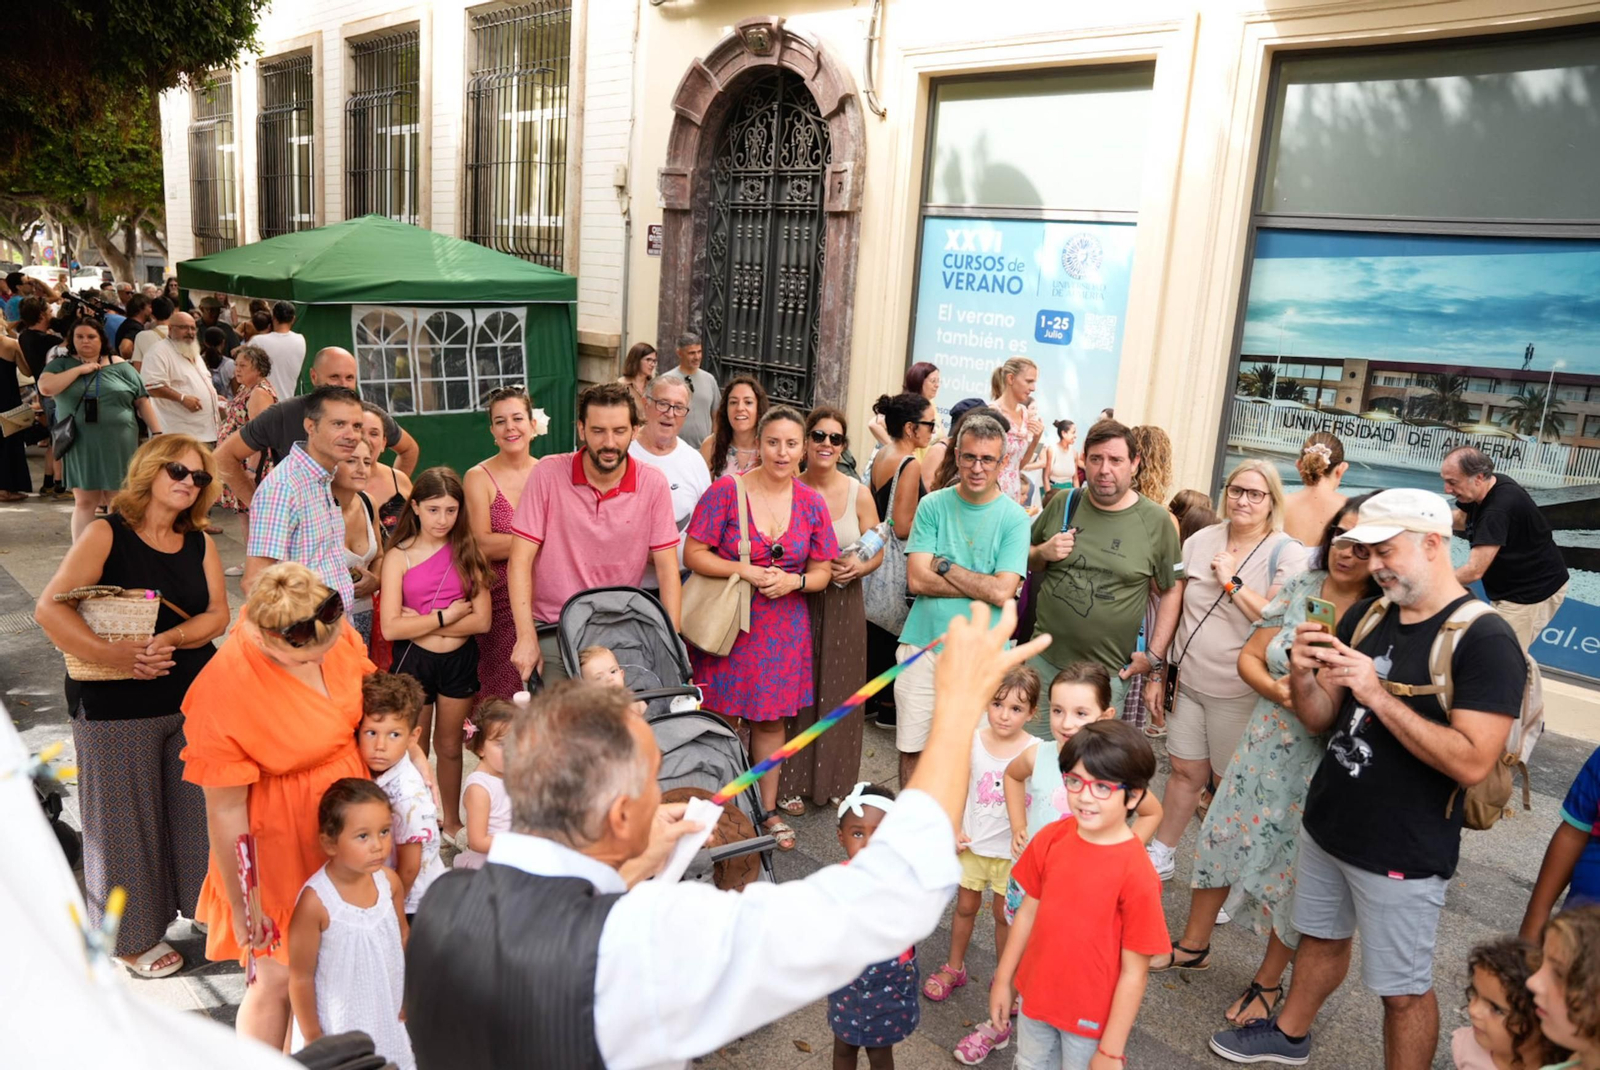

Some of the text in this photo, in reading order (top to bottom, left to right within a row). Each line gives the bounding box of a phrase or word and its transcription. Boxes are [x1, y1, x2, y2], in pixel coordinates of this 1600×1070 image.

[837, 181, 843, 194] 7
[943, 228, 1003, 253] XXVI
[942, 253, 1025, 273] CURSOS de
[942, 270, 1024, 295] VERANO
[938, 302, 1016, 328] El verano
[1041, 315, 1070, 330] 1-25
[936, 326, 1028, 353] también es
[1043, 329, 1064, 340] Julio
[934, 352, 1003, 372] moment
[1282, 411, 1522, 461] UNIVERSIDAD DE AMERIA
